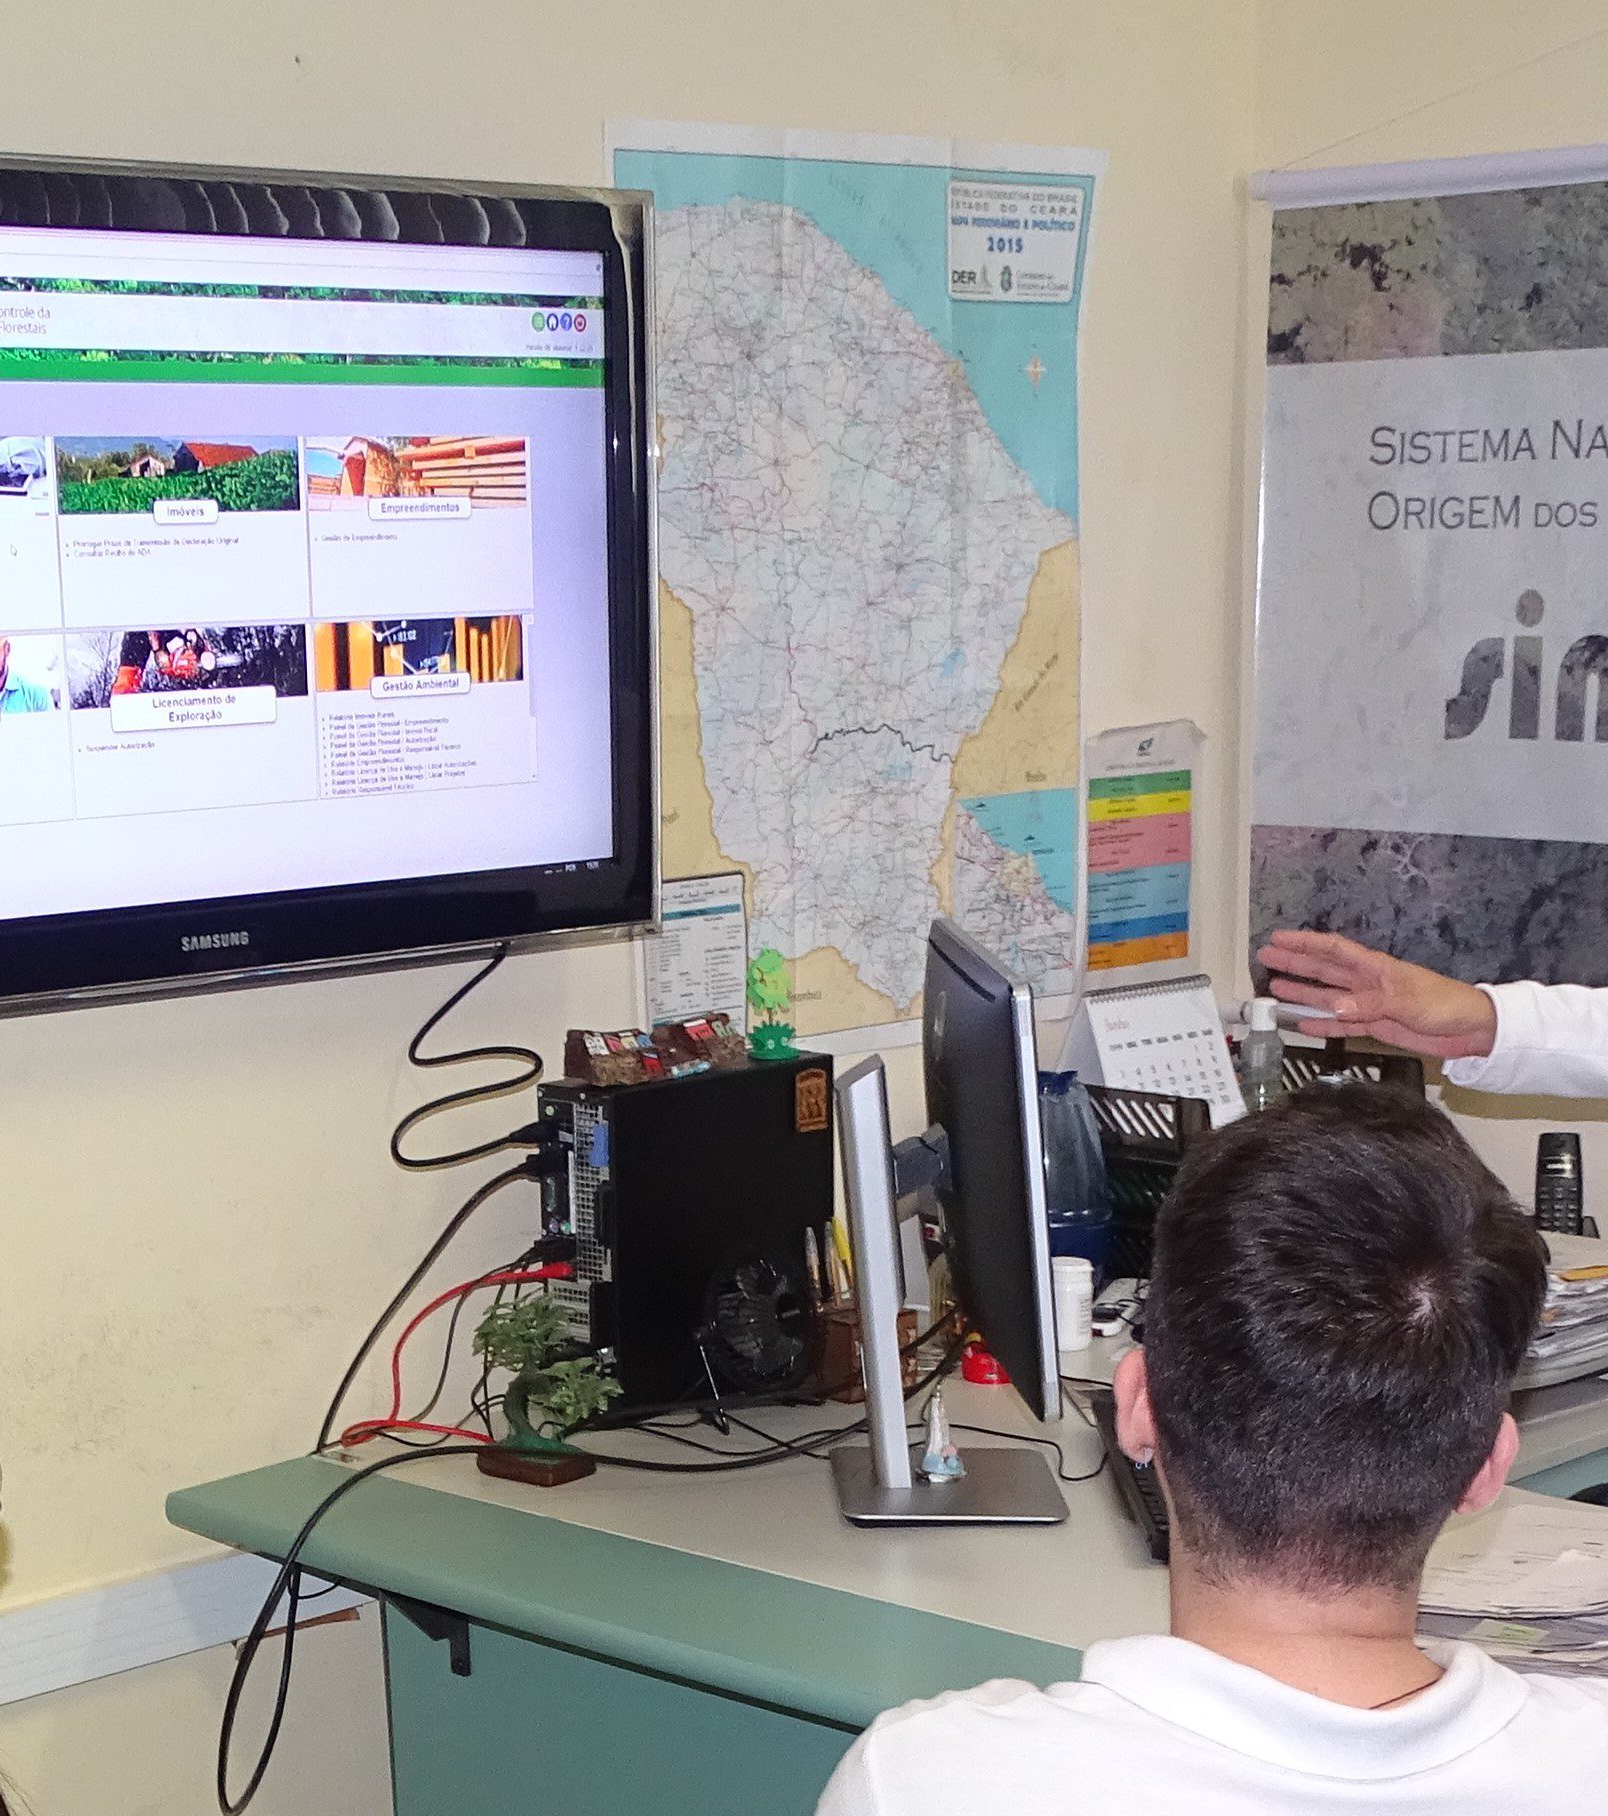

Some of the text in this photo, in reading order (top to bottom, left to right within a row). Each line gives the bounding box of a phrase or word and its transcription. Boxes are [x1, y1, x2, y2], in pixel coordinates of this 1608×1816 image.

[1000, 204, 1017, 213] DO
[987, 236, 1023, 253] 2015
[952, 270, 976, 284] DER
[37, 306, 51, 319] da
[167, 506, 205, 517] Imóveis
[381, 503, 460, 515] Empreendimentos
[383, 678, 460, 692] Gestão Ambiental
[152, 694, 236, 708] Licenciamento de
[169, 711, 222, 723] Exploração
[181, 931, 249, 952] SAMSUNG
